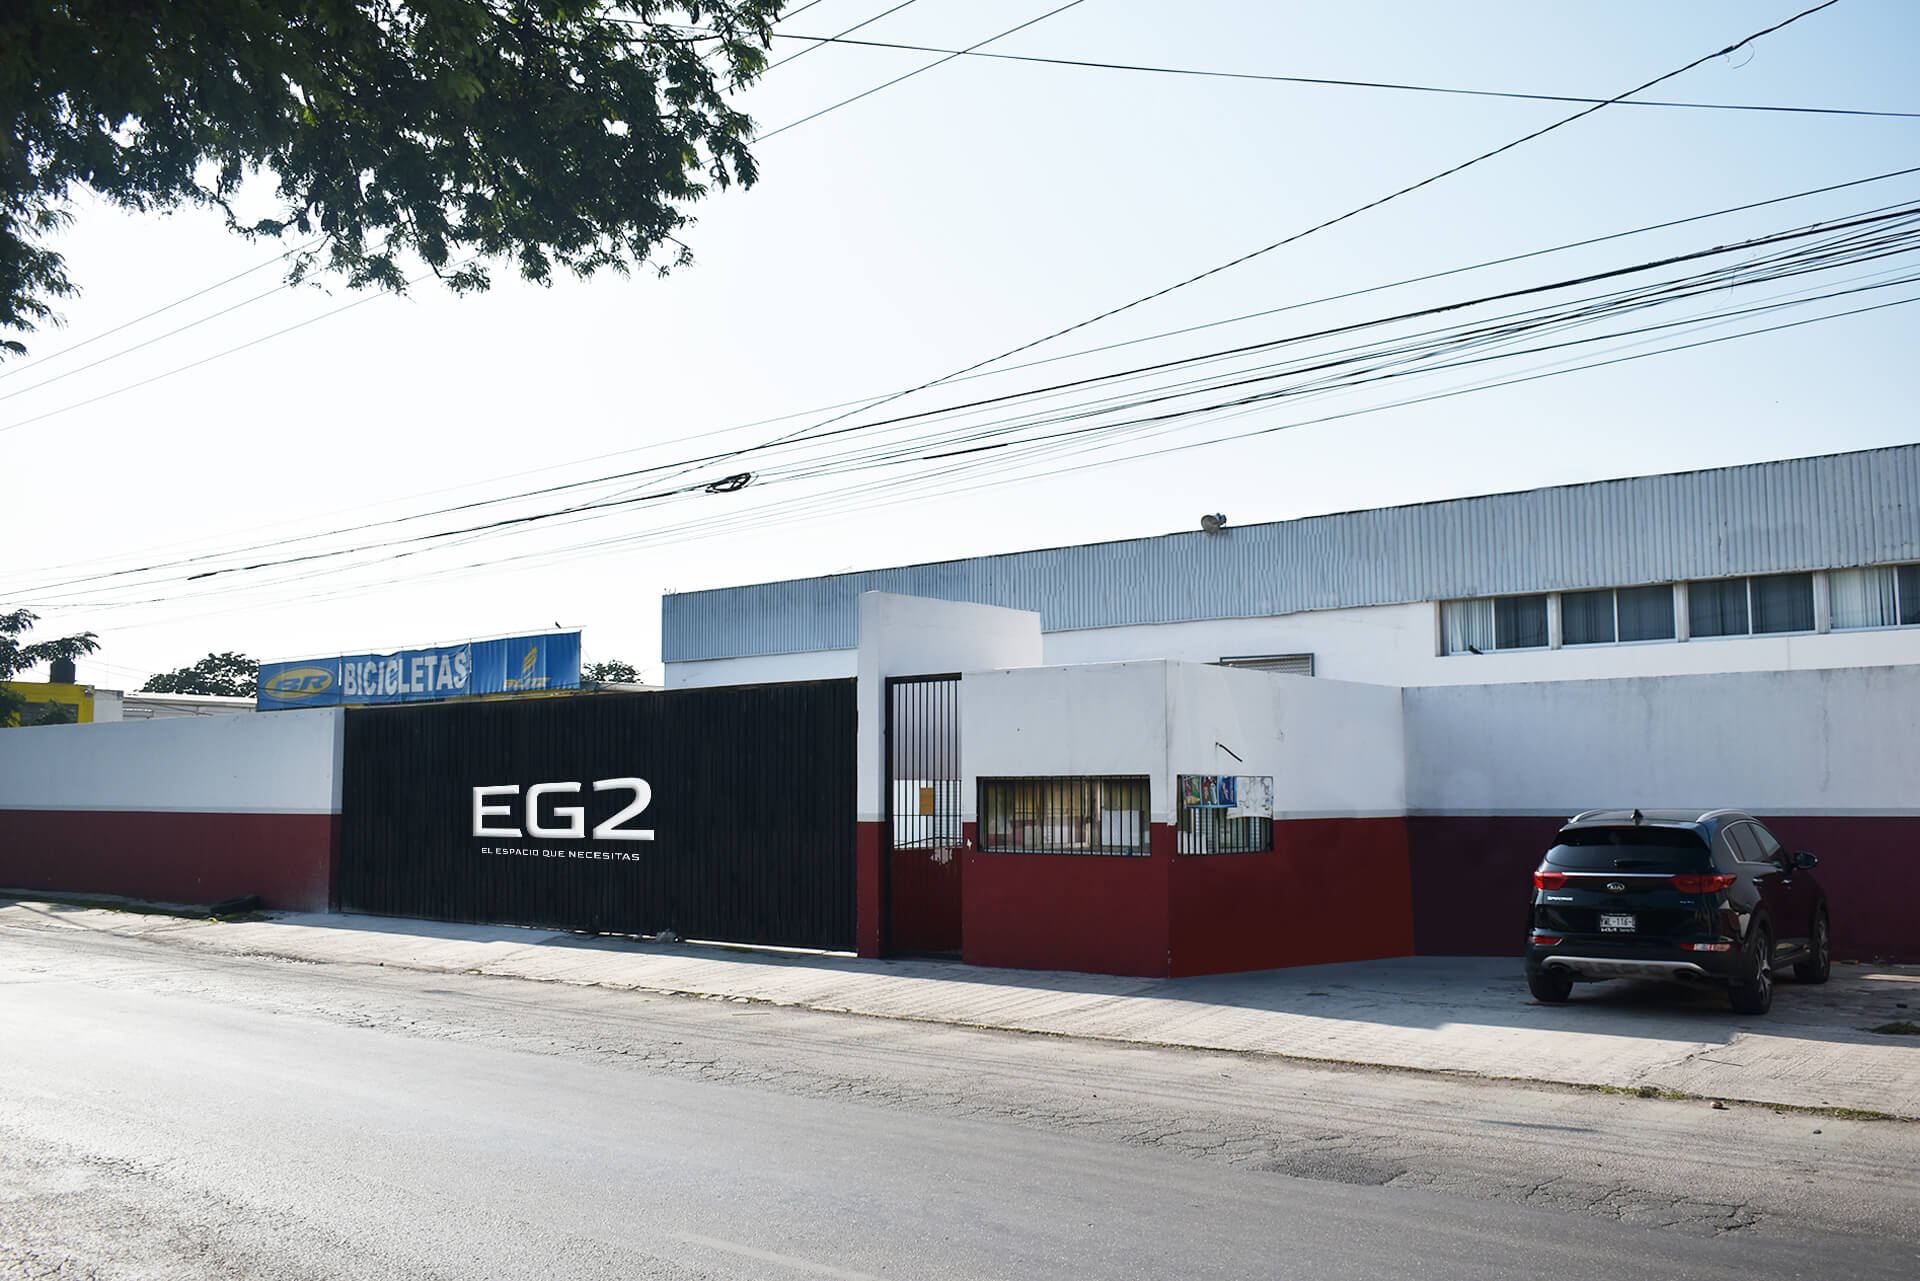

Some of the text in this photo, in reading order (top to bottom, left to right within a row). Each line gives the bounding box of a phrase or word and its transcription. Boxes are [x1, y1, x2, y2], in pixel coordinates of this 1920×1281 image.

[343, 651, 467, 696] BICICLETAS
[472, 777, 655, 841] EG2
[495, 847, 539, 857] ESPACIO
[542, 849, 566, 858] QUE
[568, 850, 640, 861] NECESITAS
